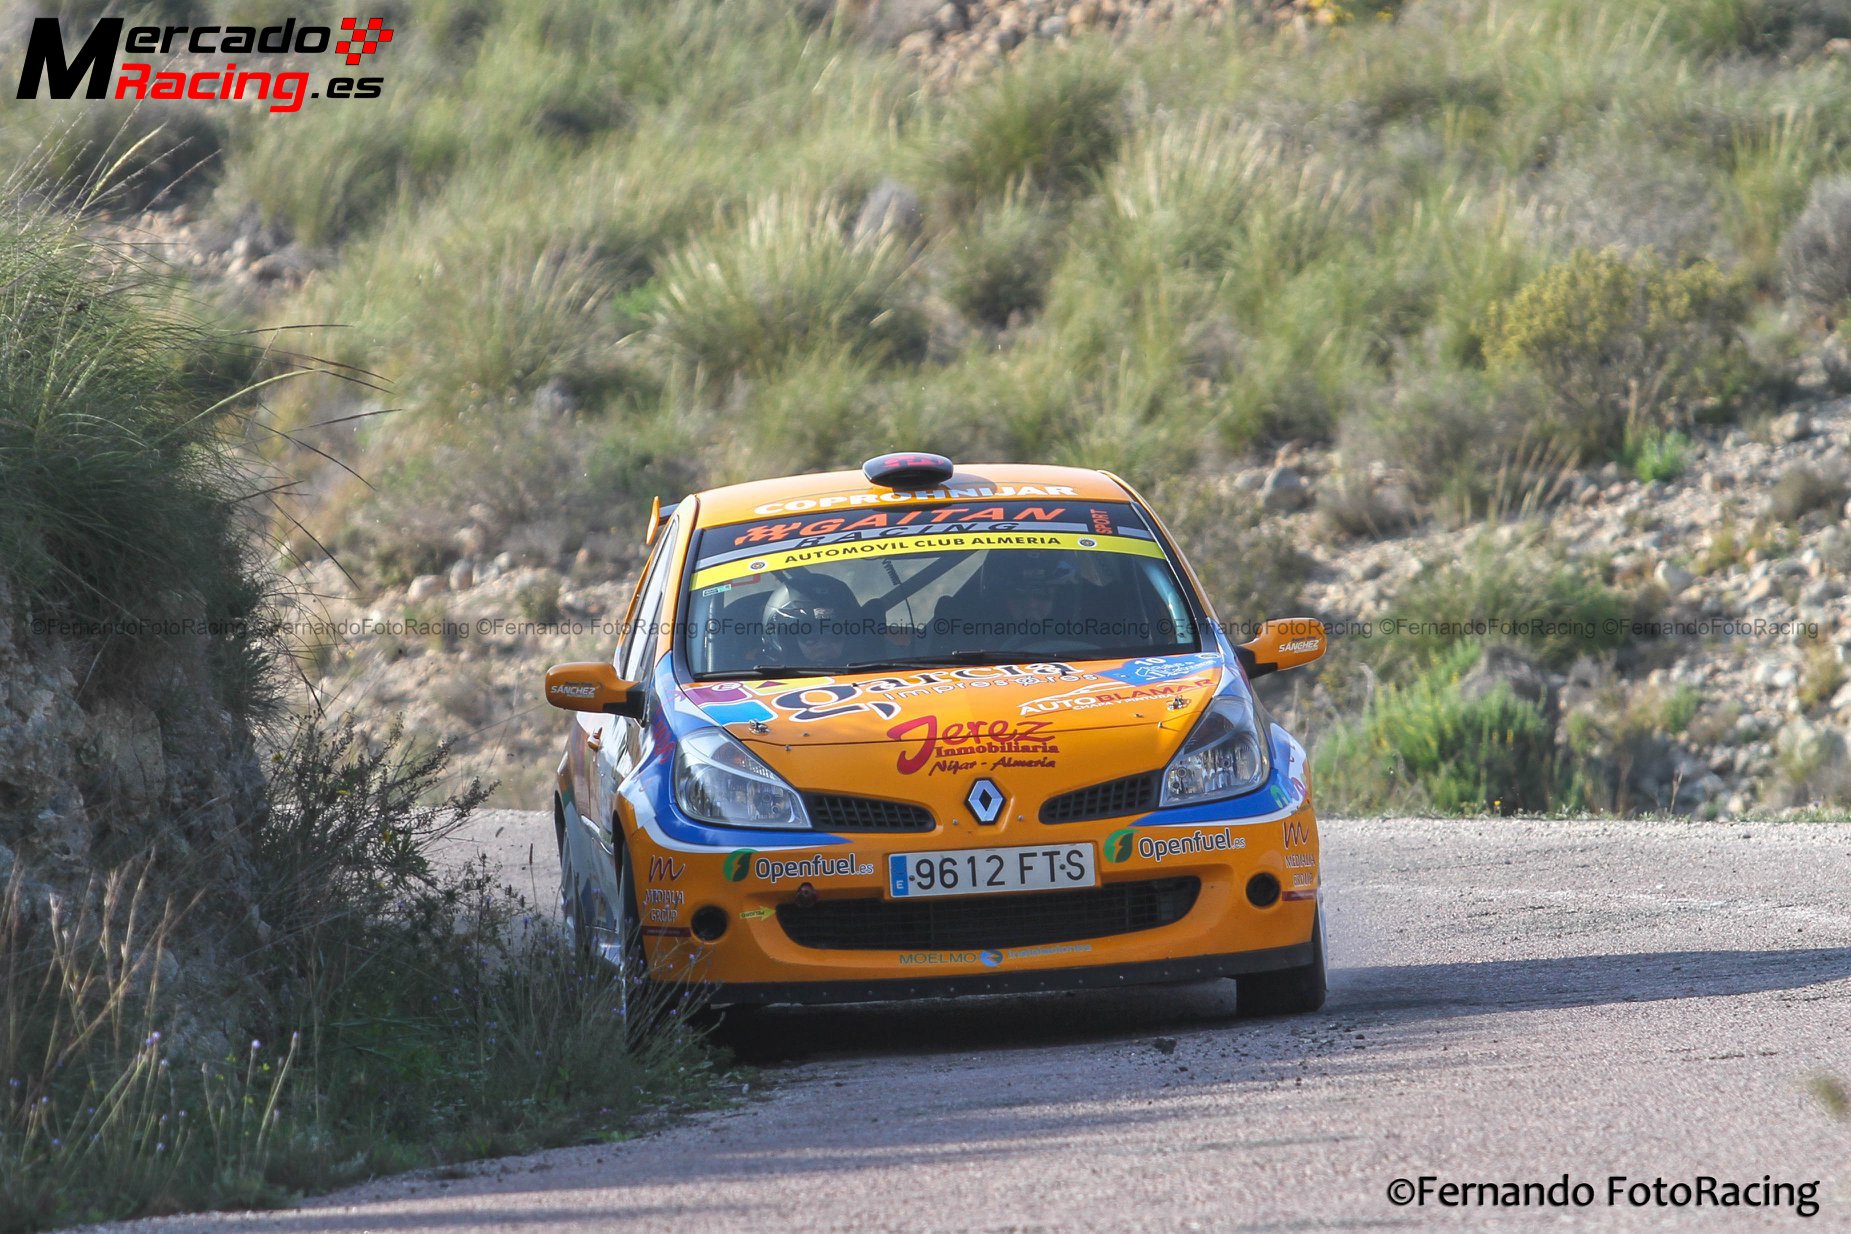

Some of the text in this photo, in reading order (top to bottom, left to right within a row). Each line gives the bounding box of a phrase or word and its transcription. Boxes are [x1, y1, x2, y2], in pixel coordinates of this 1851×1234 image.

[754, 486, 1078, 515] COPROHNIJAR
[793, 522, 1020, 550] RACING
[799, 507, 1066, 537] GAITAN
[1090, 509, 1112, 535] SPORT
[785, 536, 1061, 564] AUTOMOVIL CLUB ALMERIA
[1019, 679, 1214, 716] AUTOBLAMAR
[1072, 700, 1114, 711] CHAPA
[887, 715, 1056, 775] Jerez
[934, 741, 1060, 758] Inmobiliaria
[1138, 827, 1246, 862] Openfuel.es
[755, 852, 874, 884] Openfuel.es
[915, 849, 1086, 890] 9612 FTS
[896, 880, 905, 889] E
[899, 952, 977, 965] MOELMO
